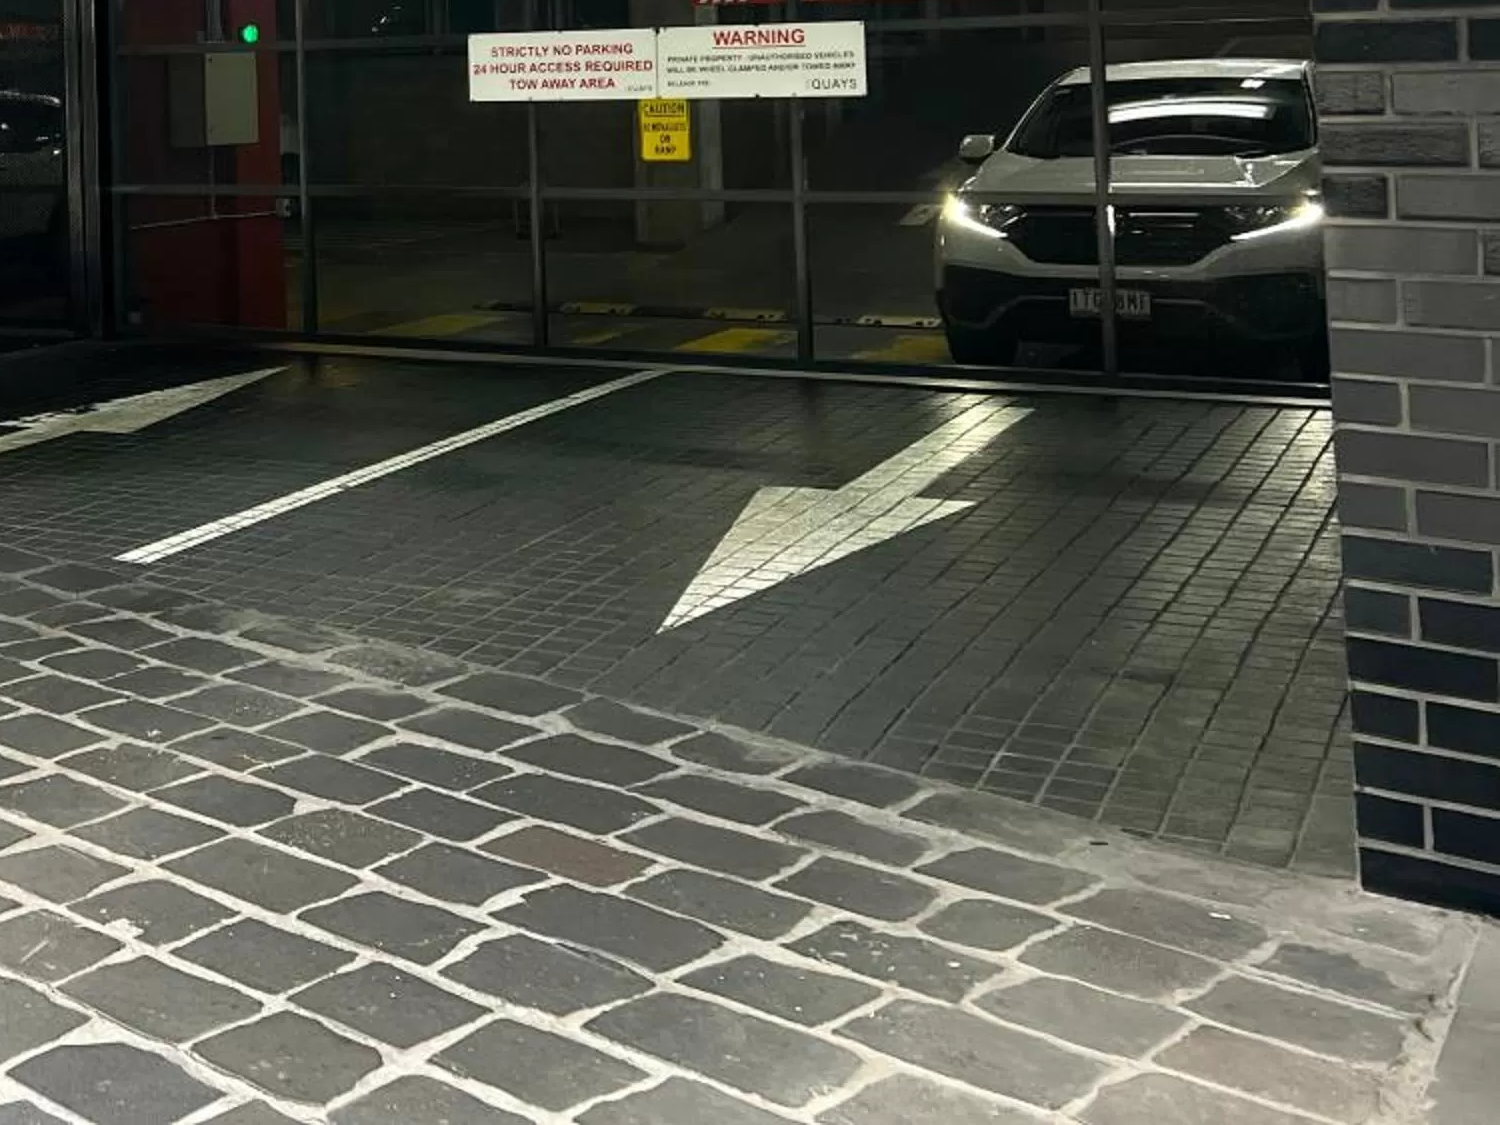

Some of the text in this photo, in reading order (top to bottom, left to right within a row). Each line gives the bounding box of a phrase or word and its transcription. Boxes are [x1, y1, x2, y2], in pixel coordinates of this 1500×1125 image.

[713, 29, 805, 45] WARNING
[491, 43, 633, 58] STRICTLY NO PARKING
[473, 60, 653, 76] 24 HOUR ACCESS REQUIRED
[509, 78, 615, 90] TOW AWAY AREA
[811, 78, 857, 90] QUAYS
